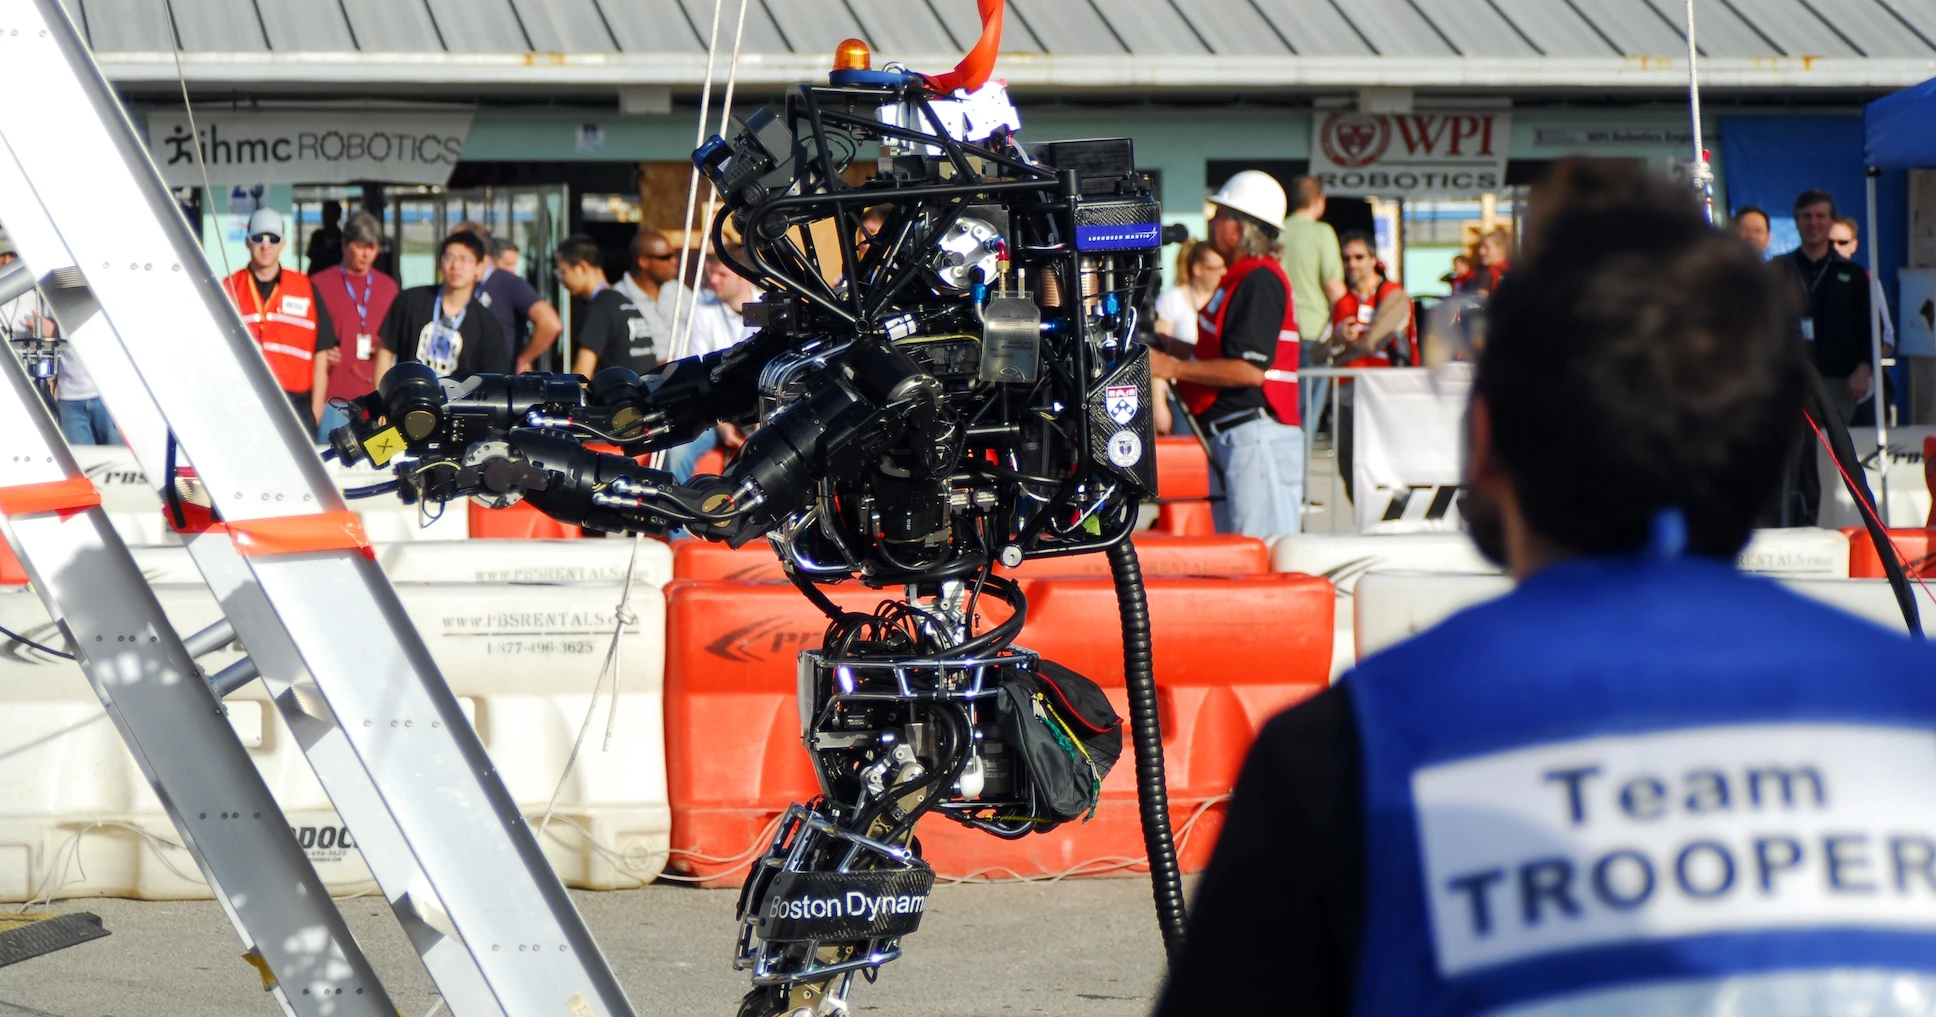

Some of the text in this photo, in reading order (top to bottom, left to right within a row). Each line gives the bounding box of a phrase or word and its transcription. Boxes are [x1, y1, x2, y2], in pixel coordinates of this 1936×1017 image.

[200, 124, 463, 166] ihmc ROBOTICS
[1394, 114, 1497, 157] WPI
[1318, 172, 1498, 190] ROBOTICS
[1543, 764, 1828, 826] Team
[769, 894, 842, 920] Boston
[1445, 834, 1936, 938] TROOPER
